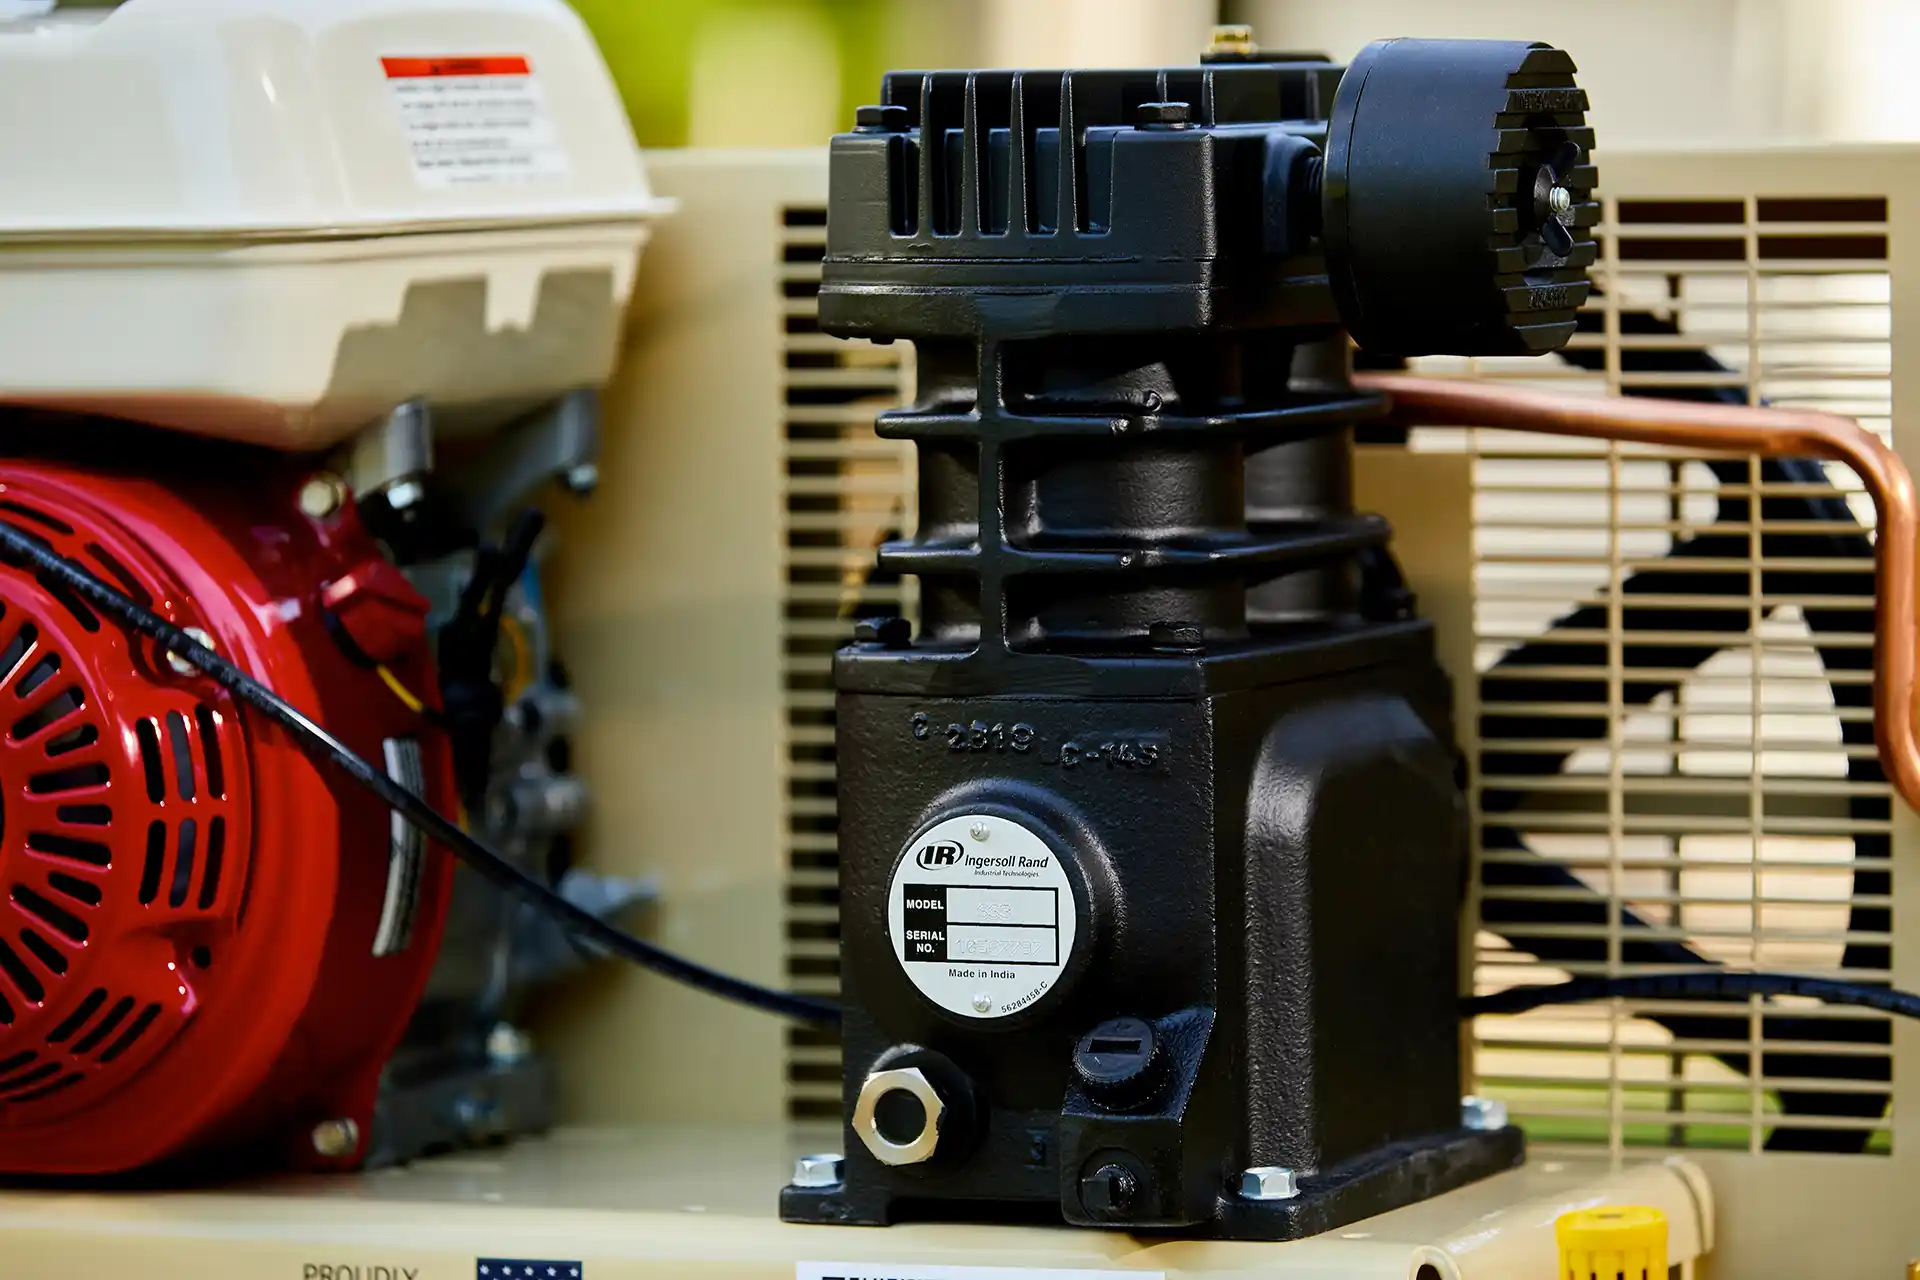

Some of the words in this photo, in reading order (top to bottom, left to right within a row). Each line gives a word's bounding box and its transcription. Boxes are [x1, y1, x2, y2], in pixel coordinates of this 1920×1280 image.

[965, 855, 1016, 869] Ingersoll
[1018, 856, 1049, 868] Rand
[1002, 870, 1039, 878] Technologies
[906, 899, 944, 910] MODEL
[906, 930, 945, 941] SERIAL
[916, 943, 935, 953] NO.
[948, 969, 975, 978] Made
[978, 969, 987, 978] in
[990, 970, 1016, 979] India
[1001, 980, 1048, 1013] 56284458-C
